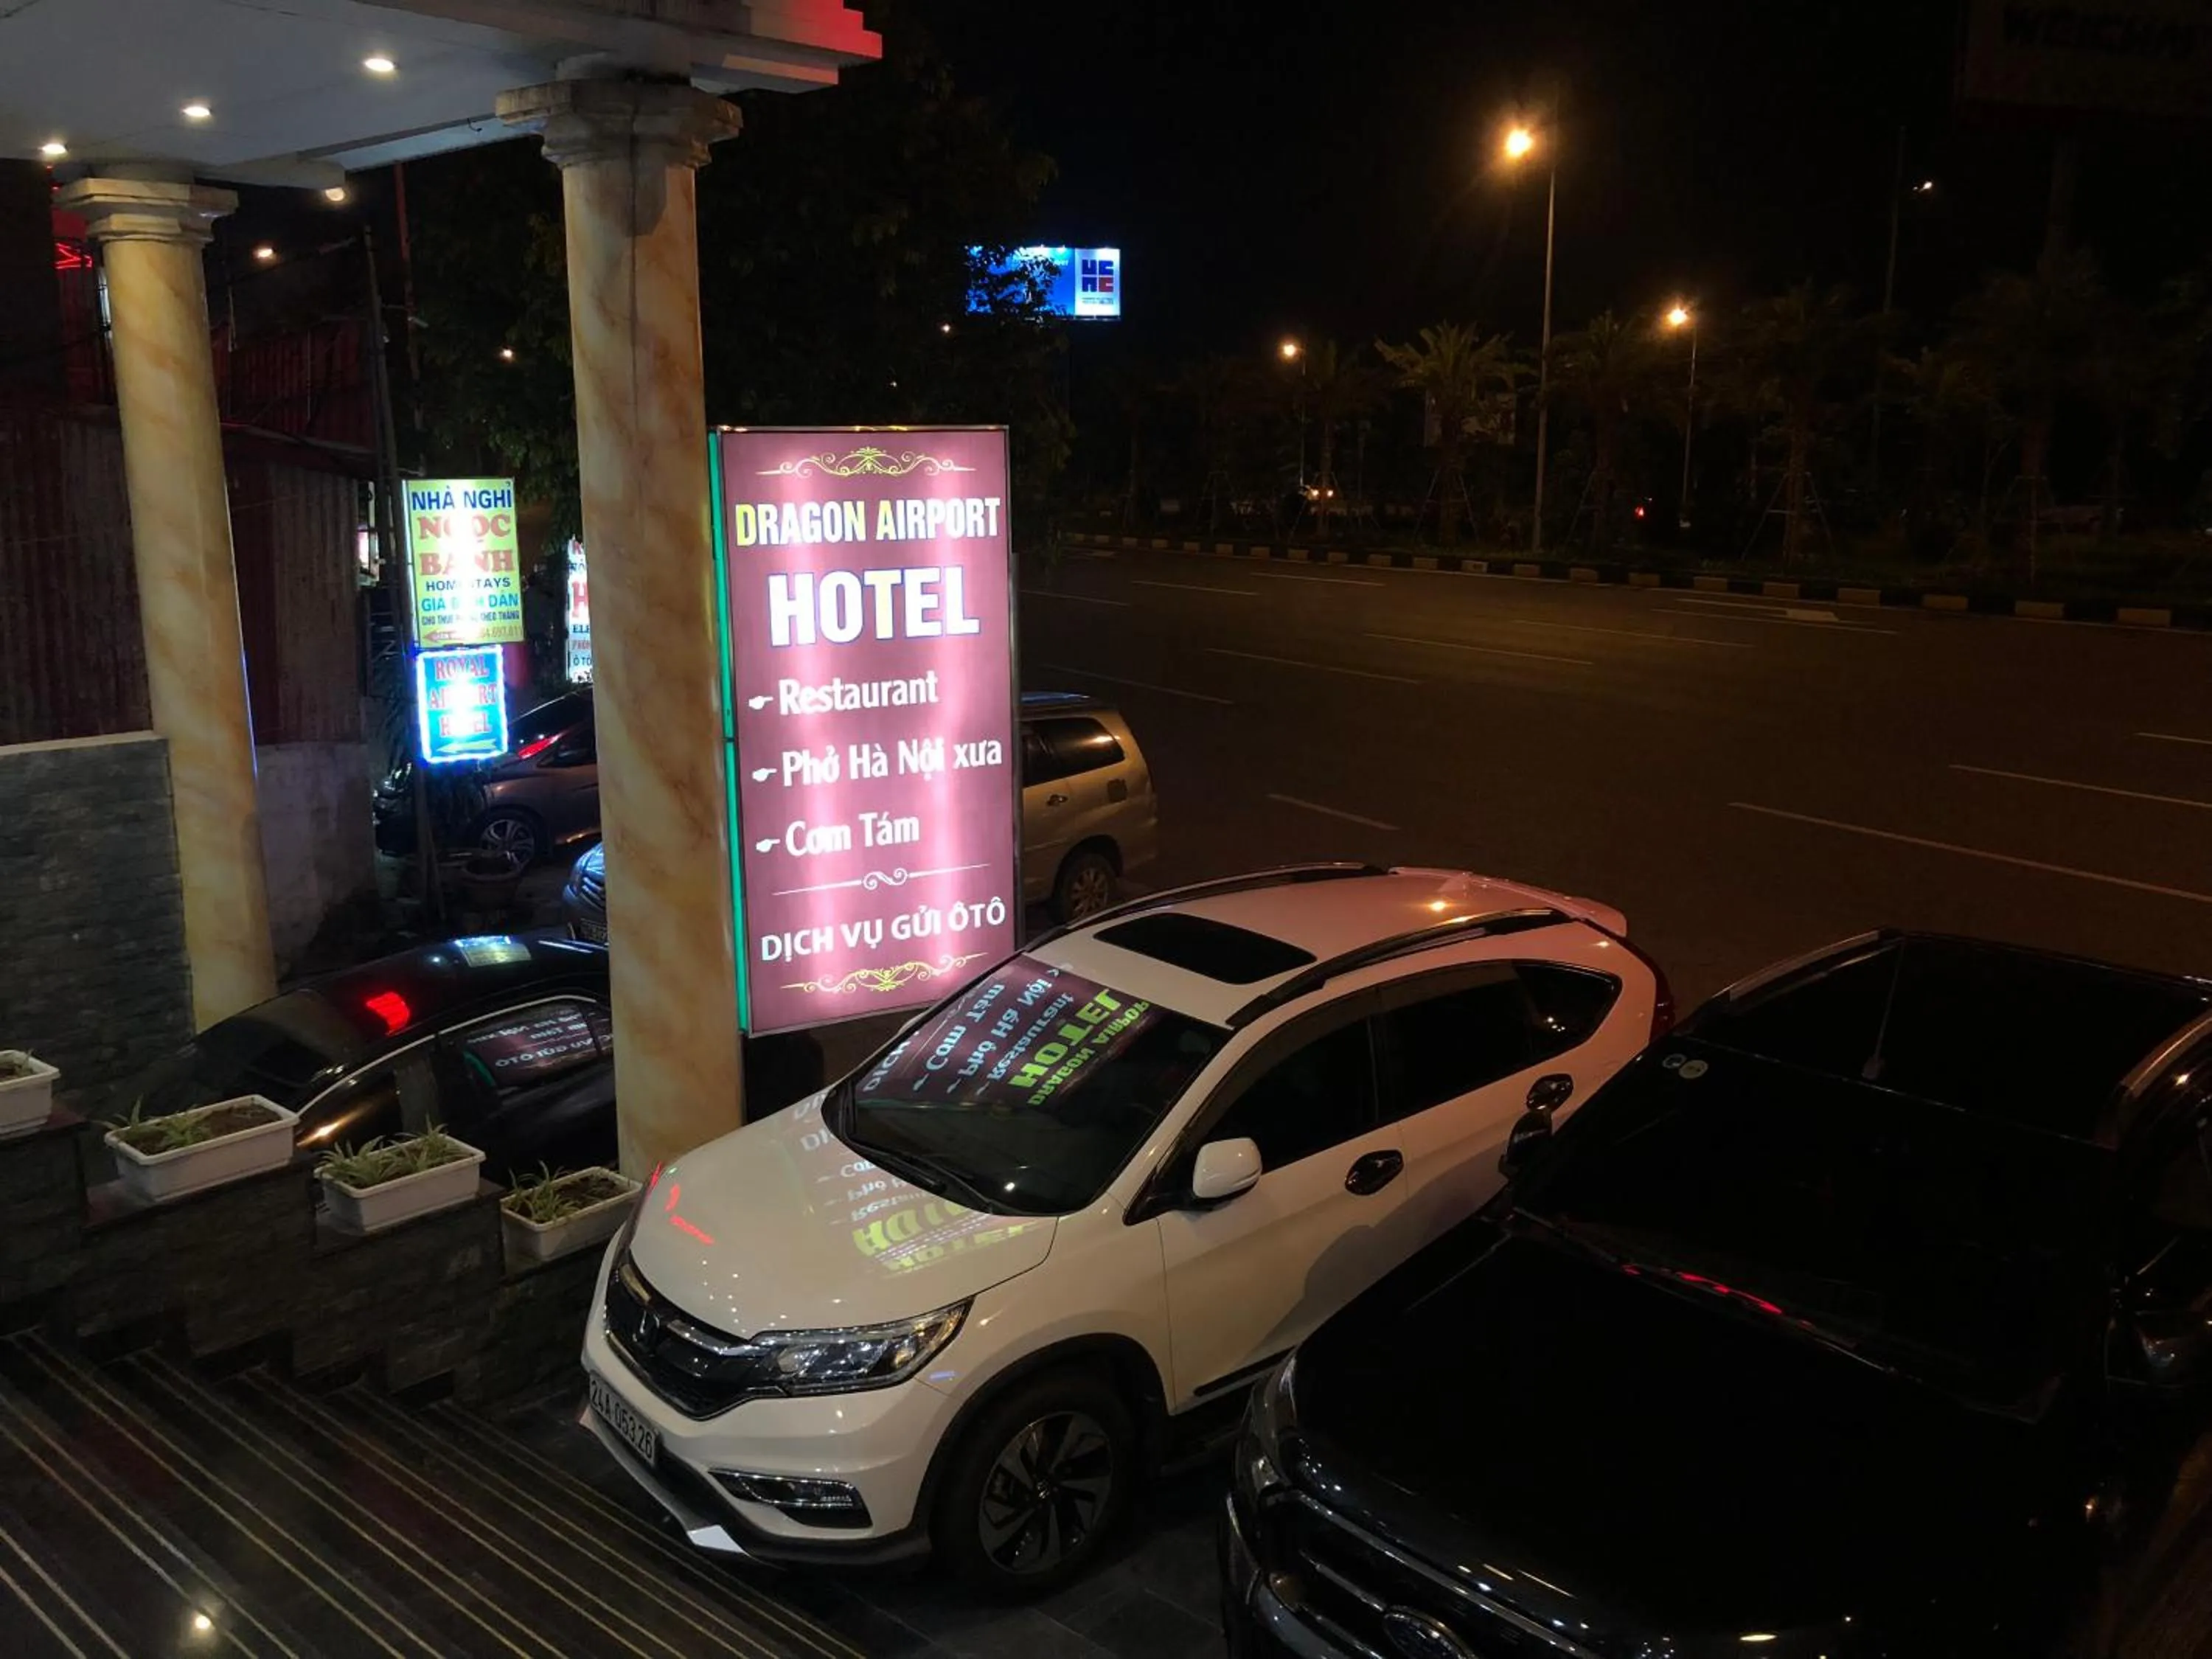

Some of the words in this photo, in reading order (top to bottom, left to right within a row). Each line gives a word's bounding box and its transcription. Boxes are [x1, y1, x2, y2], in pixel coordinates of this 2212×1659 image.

[412, 485, 455, 510] NHÀ
[463, 481, 512, 509] NGHỈ
[735, 500, 866, 547] DRAGON
[876, 497, 1001, 541] AIRPORT
[768, 566, 981, 647] HOTEL
[779, 669, 938, 715] Restaurant
[782, 745, 839, 786] Phở
[849, 743, 886, 779] Hà
[898, 737, 945, 781] Nội
[953, 739, 1002, 770] xưa
[858, 811, 919, 847] Tám
[761, 925, 832, 963] DỊCH
[841, 918, 883, 950] VỤ
[891, 905, 942, 942] GỬI
[947, 897, 1005, 933] ÔTÔ
